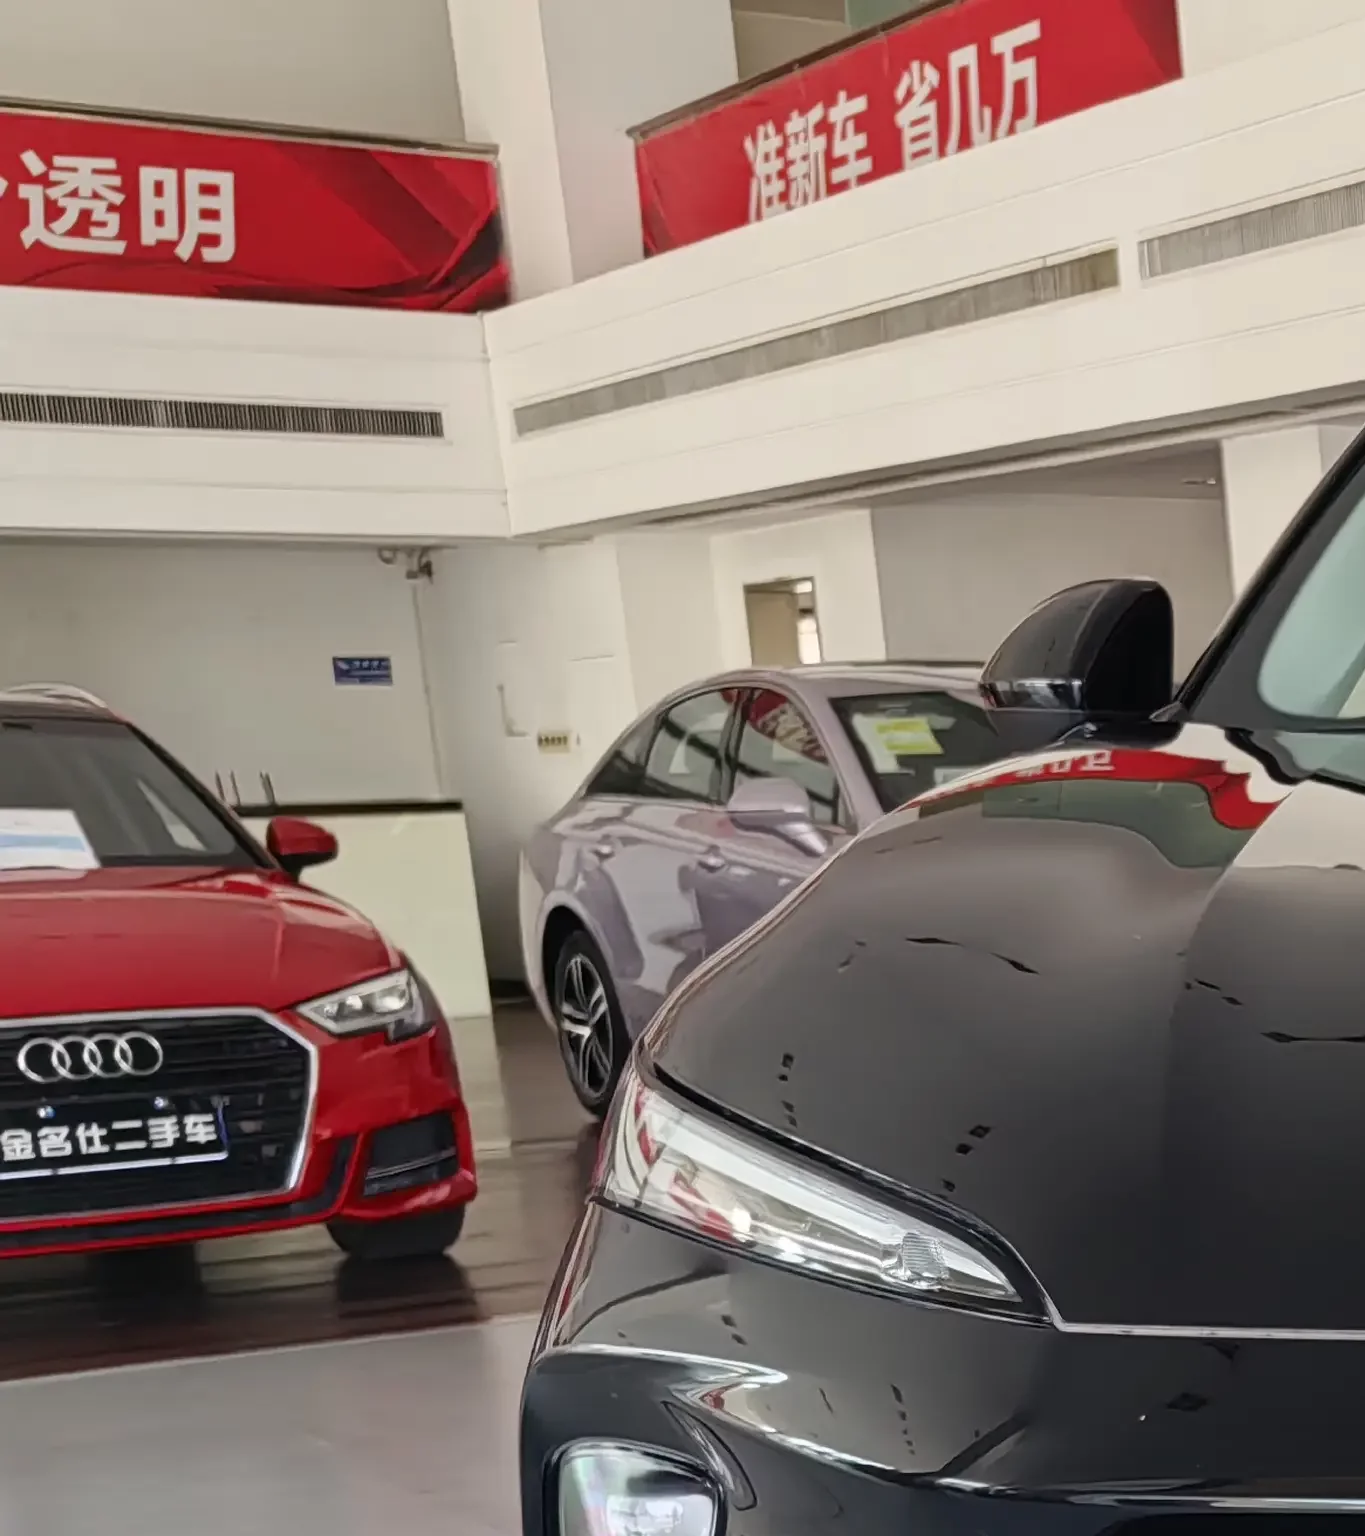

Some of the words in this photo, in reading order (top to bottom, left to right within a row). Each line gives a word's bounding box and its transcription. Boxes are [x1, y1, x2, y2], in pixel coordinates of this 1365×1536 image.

[743, 91, 873, 223] 准新车
[894, 18, 1041, 171] 省几万
[0, 149, 236, 264] 透明
[0, 1113, 218, 1162] 金名仕二手车
